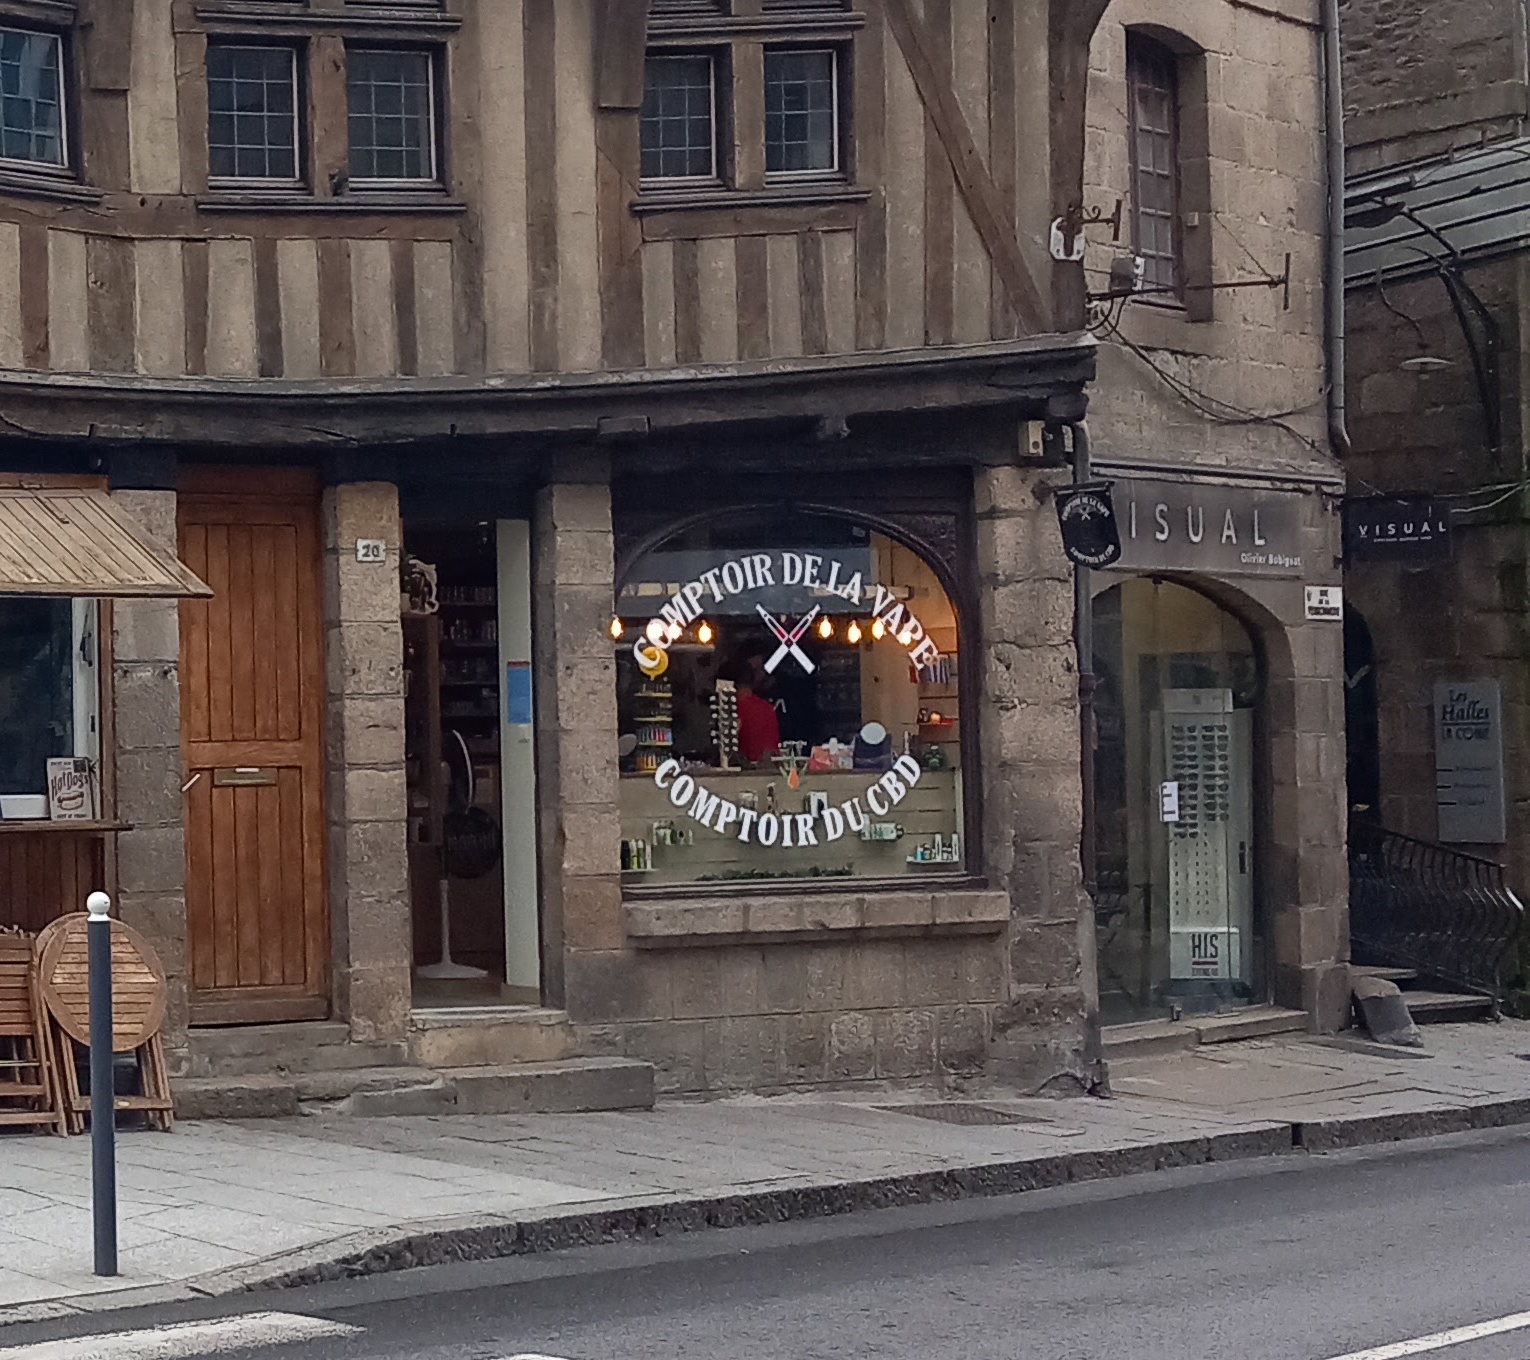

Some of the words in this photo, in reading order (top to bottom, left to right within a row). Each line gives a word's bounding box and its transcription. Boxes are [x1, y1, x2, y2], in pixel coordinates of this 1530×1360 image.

[1130, 501, 1266, 546] ISUAL
[1358, 521, 1446, 538] VISUAL
[361, 544, 380, 558] 20
[633, 553, 775, 669] COMPTOIR
[781, 552, 822, 588] DE
[826, 560, 863, 606] LA
[869, 584, 939, 670] VAPE
[1441, 700, 1490, 721] Halles
[654, 758, 818, 847] COMPTOIR
[821, 797, 865, 841] DU
[866, 754, 922, 816] CBD
[1191, 933, 1219, 959] HIS
